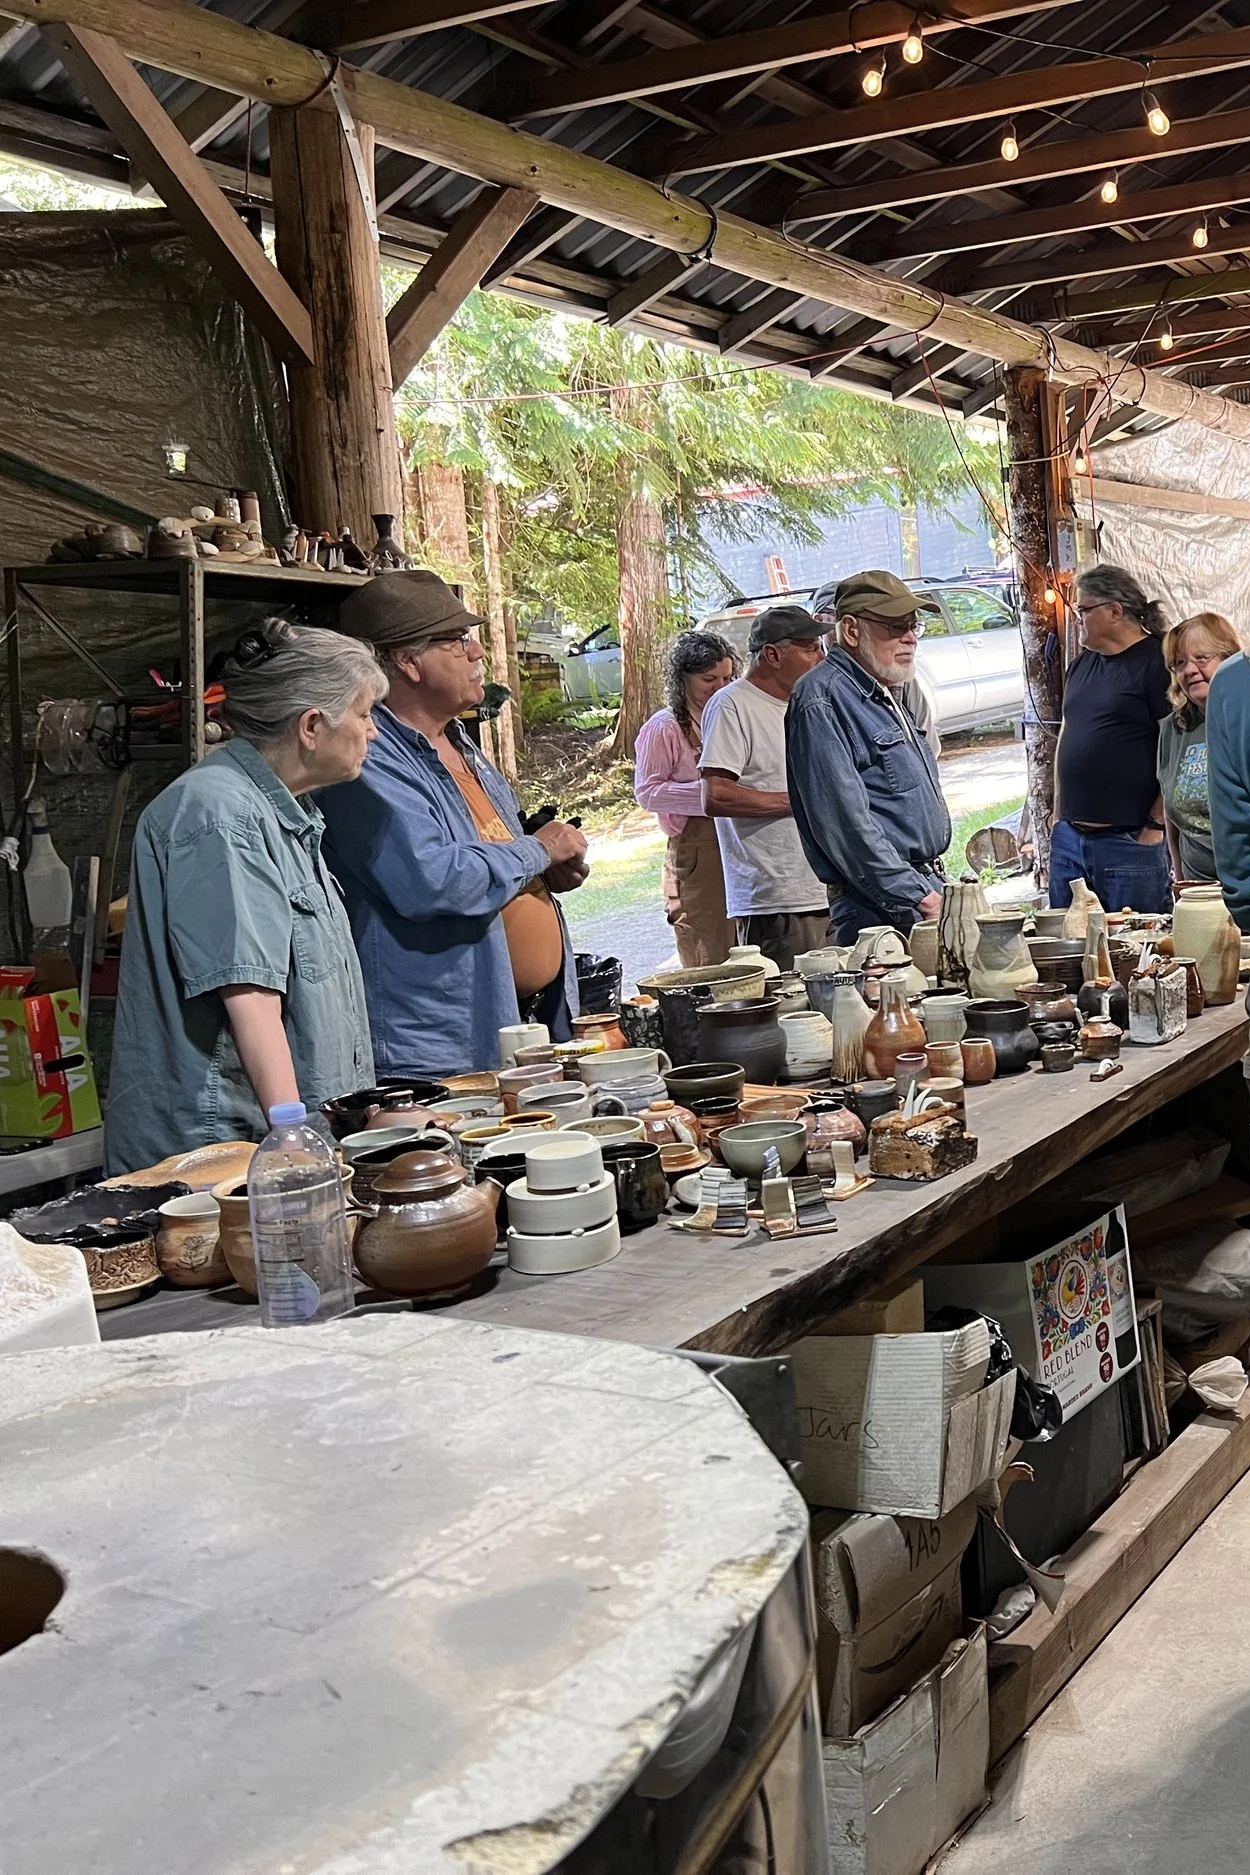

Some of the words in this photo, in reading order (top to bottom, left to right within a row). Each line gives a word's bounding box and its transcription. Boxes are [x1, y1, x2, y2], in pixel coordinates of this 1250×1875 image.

[60, 1036, 88, 1093] AA
[1044, 1356, 1062, 1379] RED
[1065, 1335, 1092, 1364] BLEND
[1047, 1366, 1075, 1389] ORTUGAL
[797, 1407, 879, 1449] Jars
